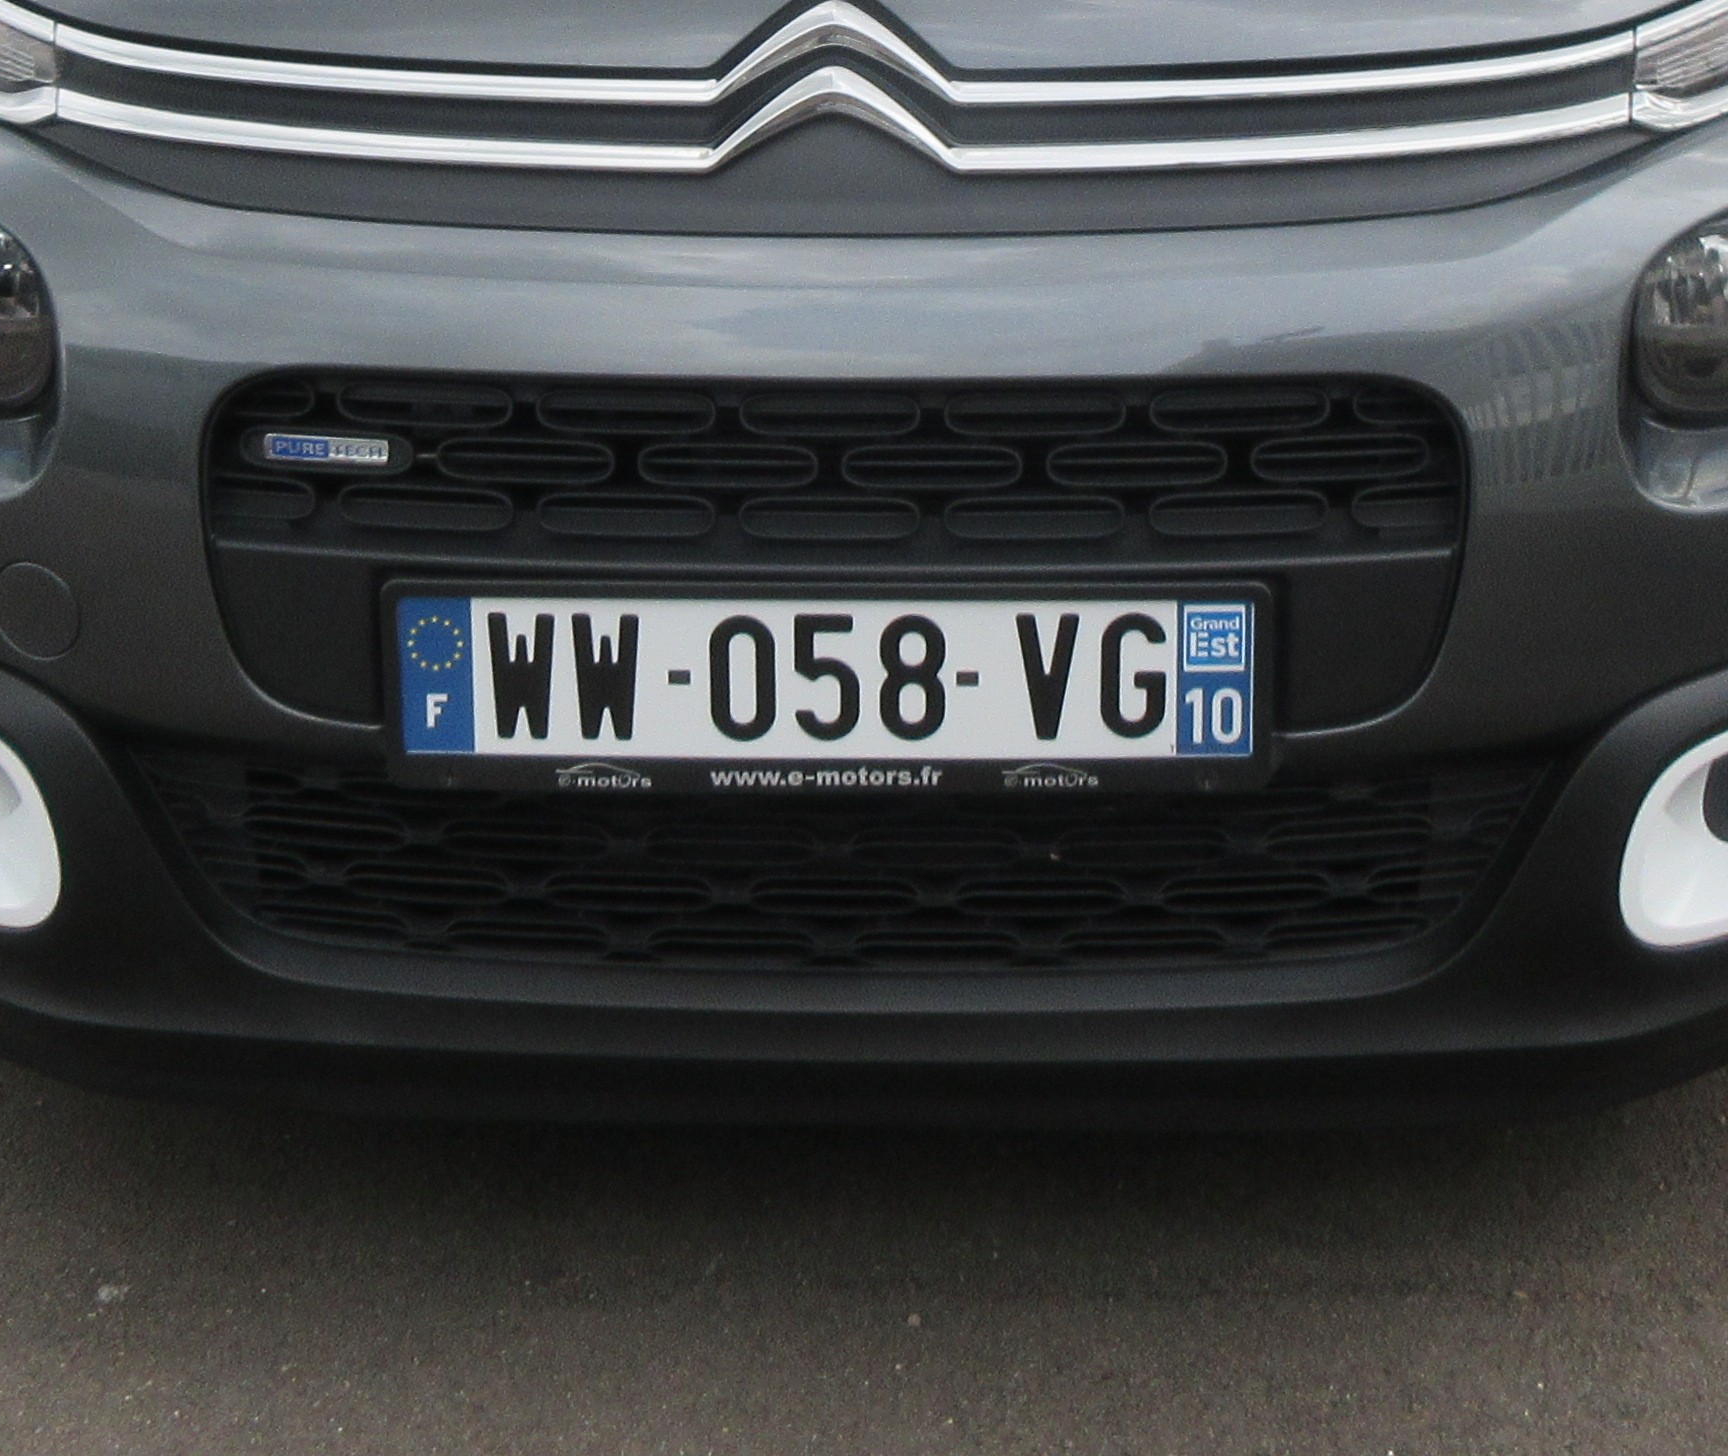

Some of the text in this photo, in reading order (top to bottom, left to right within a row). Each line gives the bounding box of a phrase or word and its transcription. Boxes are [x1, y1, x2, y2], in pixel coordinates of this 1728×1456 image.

[1190, 617, 1240, 630] Grand
[1189, 632, 1239, 658] Est
[426, 693, 449, 729] F
[1185, 687, 1243, 744] 10
[710, 767, 943, 787] www.e-motors.fr
